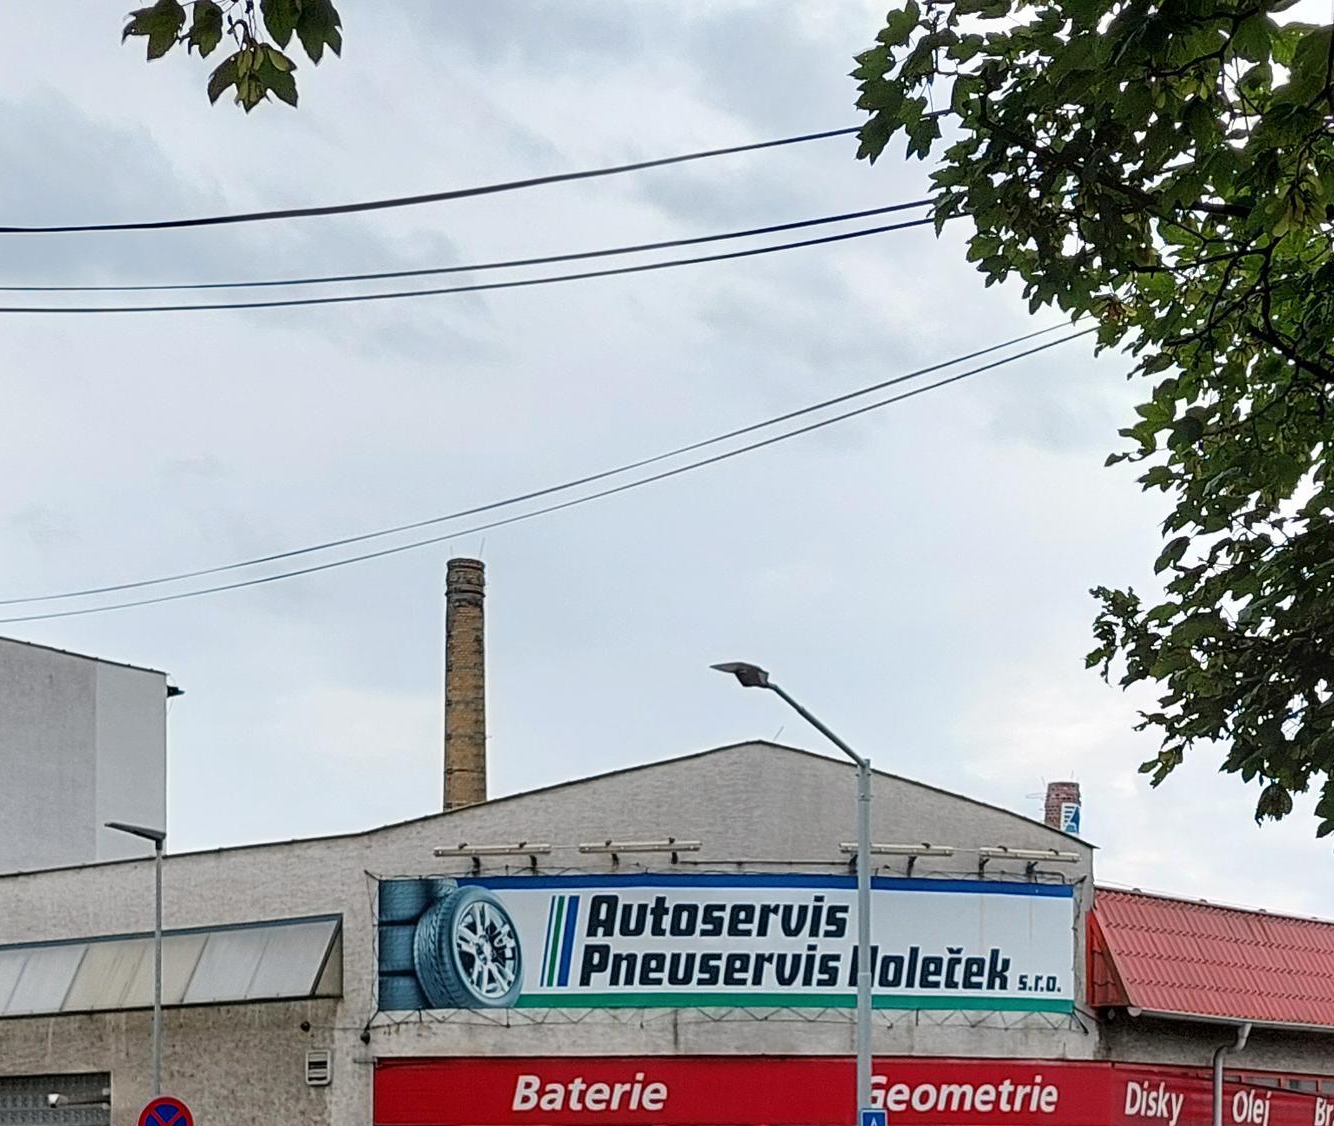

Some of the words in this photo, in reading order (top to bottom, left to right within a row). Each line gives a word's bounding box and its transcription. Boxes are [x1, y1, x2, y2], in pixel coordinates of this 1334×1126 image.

[586, 894, 849, 938] Autoservis
[579, 944, 842, 987] Pneuservis
[1018, 974, 1062, 992] s.r.o.
[512, 1073, 667, 1112] Baterie
[869, 1075, 1059, 1113] Geometrie
